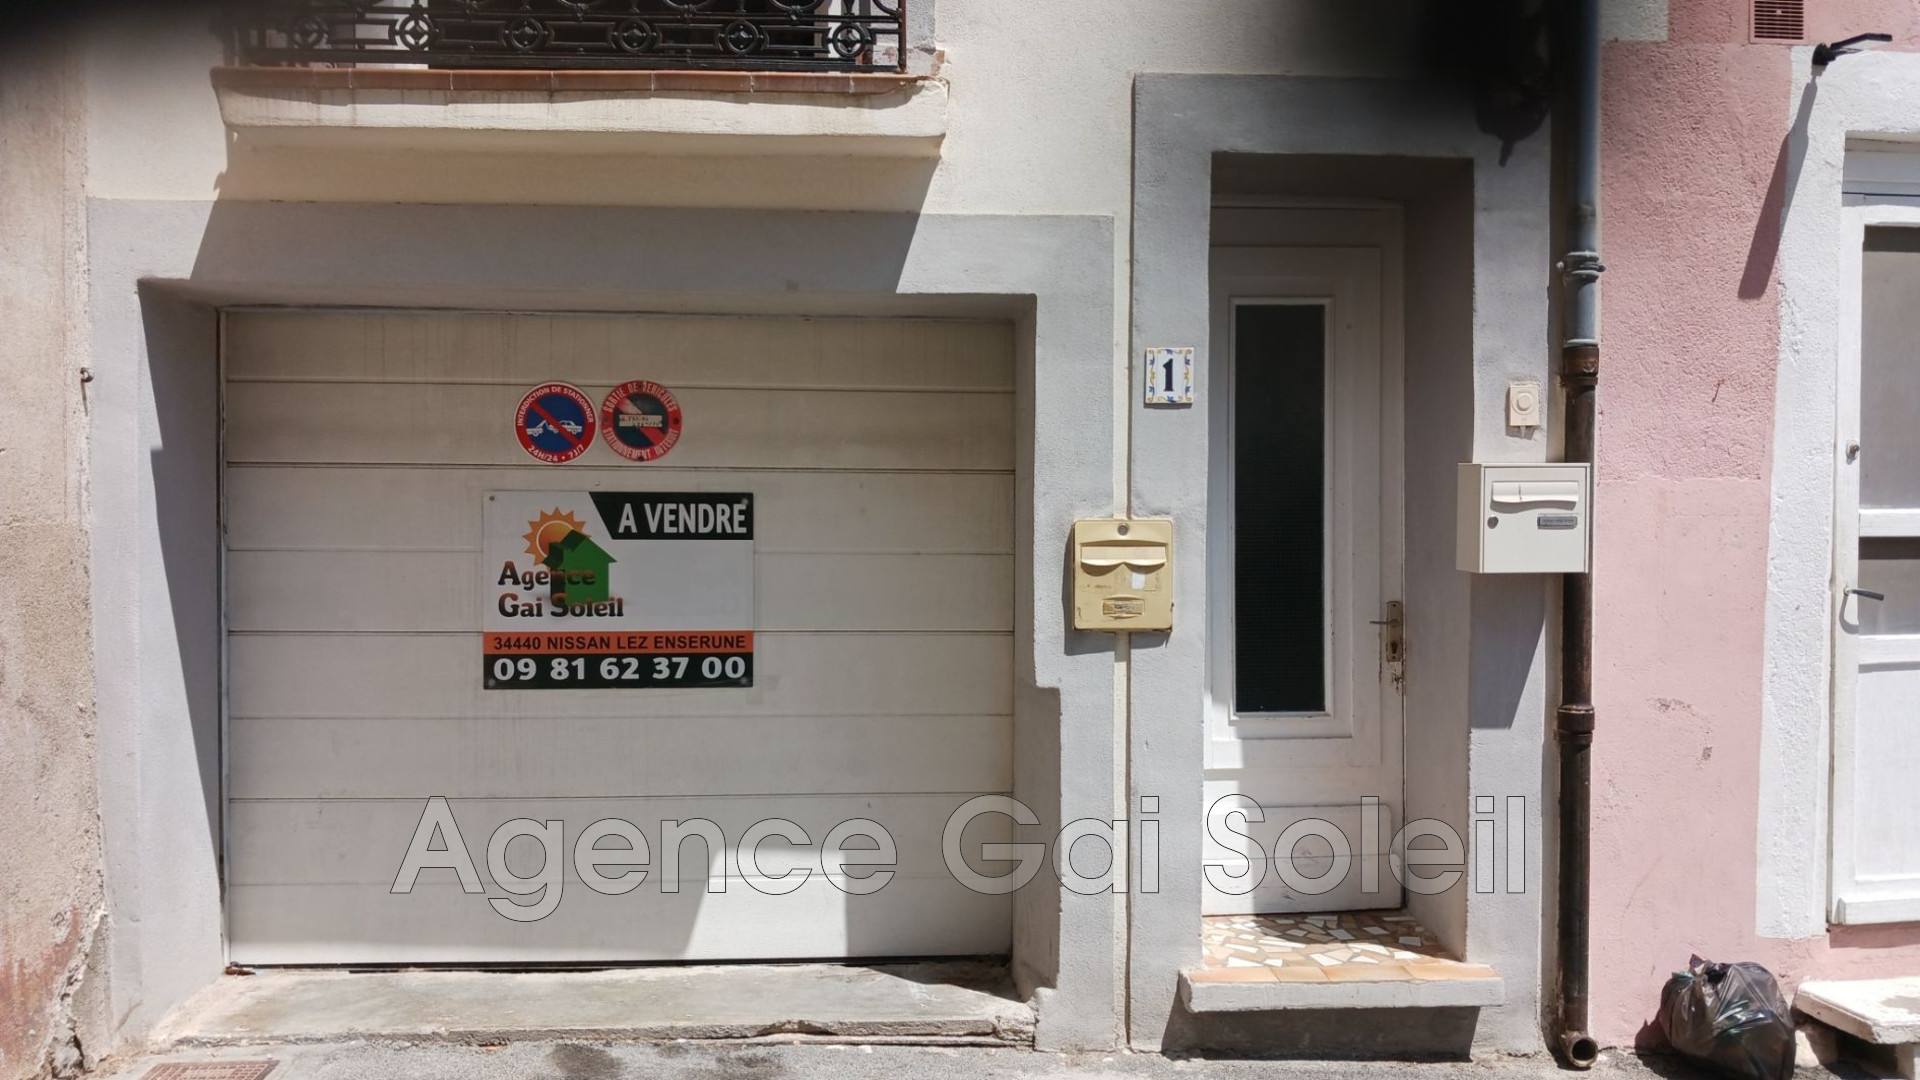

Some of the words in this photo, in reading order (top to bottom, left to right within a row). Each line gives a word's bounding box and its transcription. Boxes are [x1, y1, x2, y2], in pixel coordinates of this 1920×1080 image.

[1163, 358, 1174, 392] 1
[517, 387, 550, 427] INTERDICTION
[563, 387, 594, 423] STATIONNER
[602, 387, 626, 413] SORTIE
[627, 382, 638, 393] DE
[528, 445, 558, 462] 24H/24
[568, 443, 585, 459] 7J/7
[653, 428, 680, 456] INTERDIT
[618, 503, 638, 533] A
[644, 503, 747, 534] VENDRE
[498, 561, 595, 591] Agence
[498, 593, 543, 617] Gai
[550, 593, 624, 617] Soleil
[494, 637, 541, 650] 34440
[547, 636, 610, 650] NISSAN
[617, 636, 648, 650] LEZ
[654, 636, 746, 649] ENSERUNE
[493, 658, 537, 681] 09
[550, 658, 586, 680] 81
[600, 658, 639, 680] 62
[652, 658, 690, 679] 37
[701, 656, 746, 679] 00
